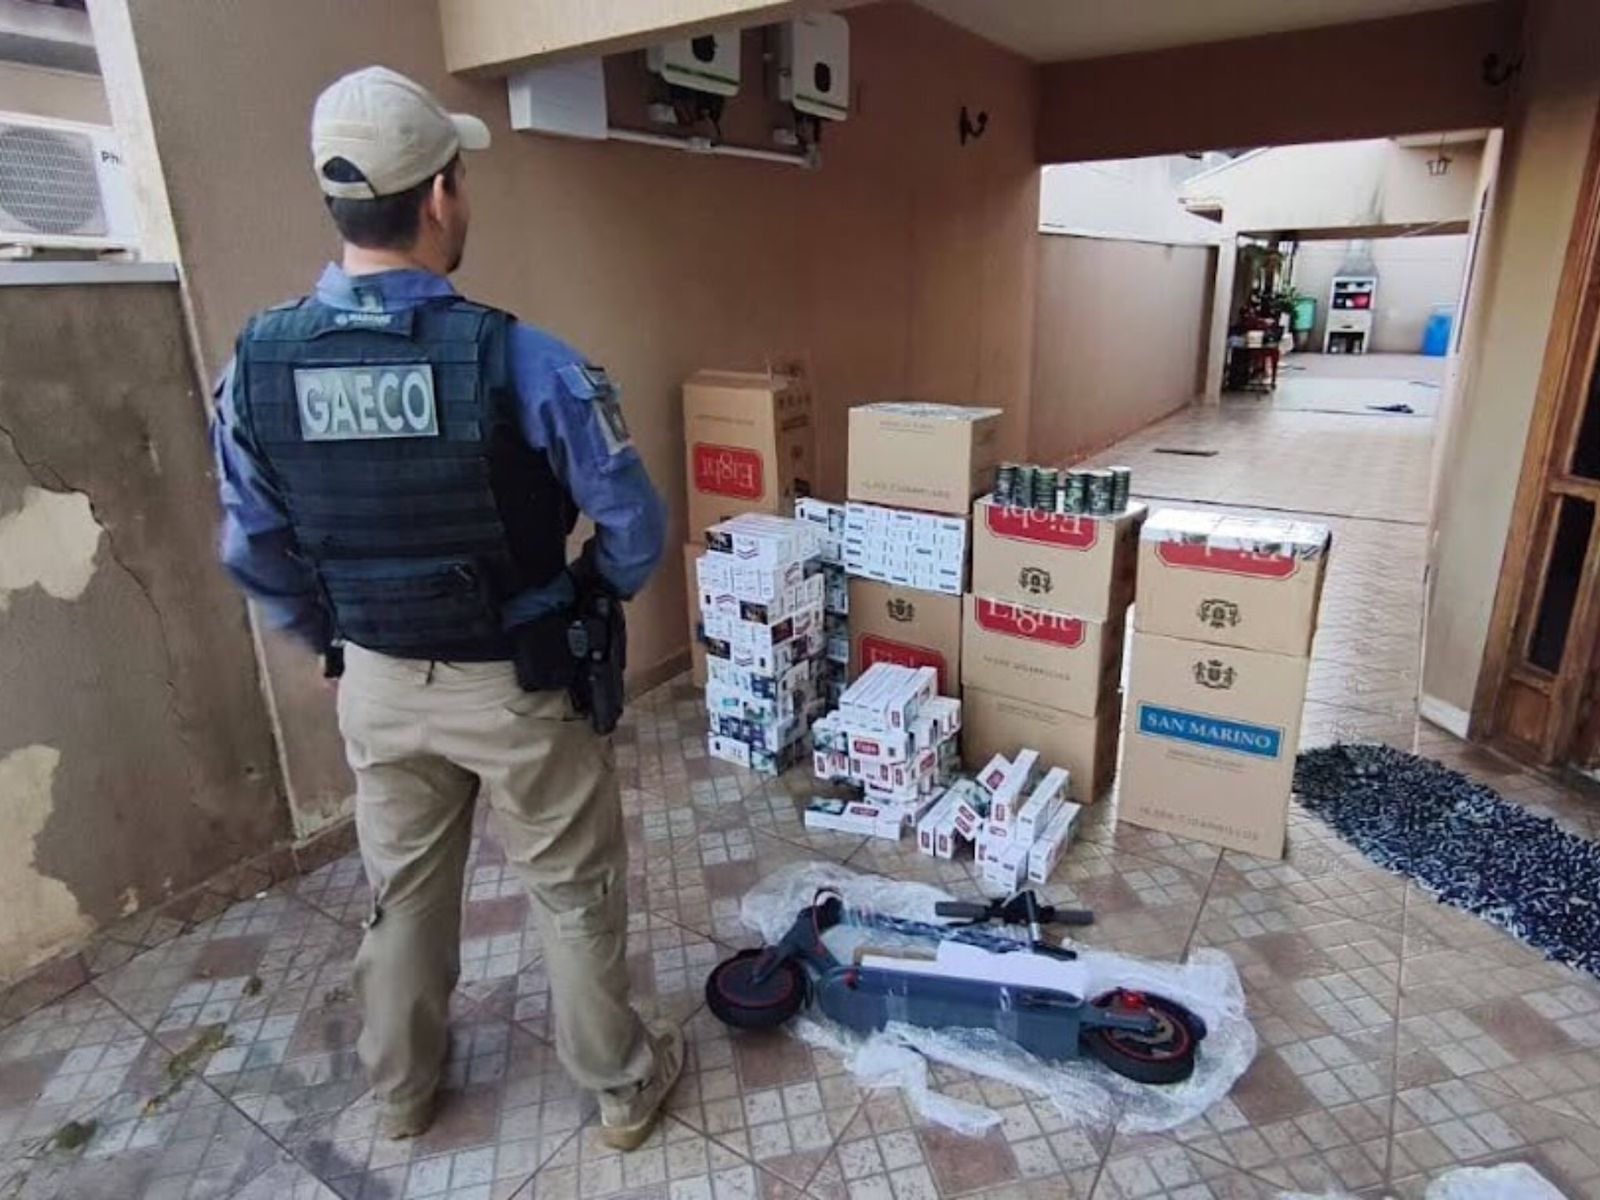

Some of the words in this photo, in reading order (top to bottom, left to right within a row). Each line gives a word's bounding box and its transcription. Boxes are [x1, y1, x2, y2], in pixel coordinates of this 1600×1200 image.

[303, 371, 431, 433] GAECO
[700, 450, 755, 490] Eight
[1146, 712, 1186, 733] SAN
[1189, 721, 1272, 749] MARINO
